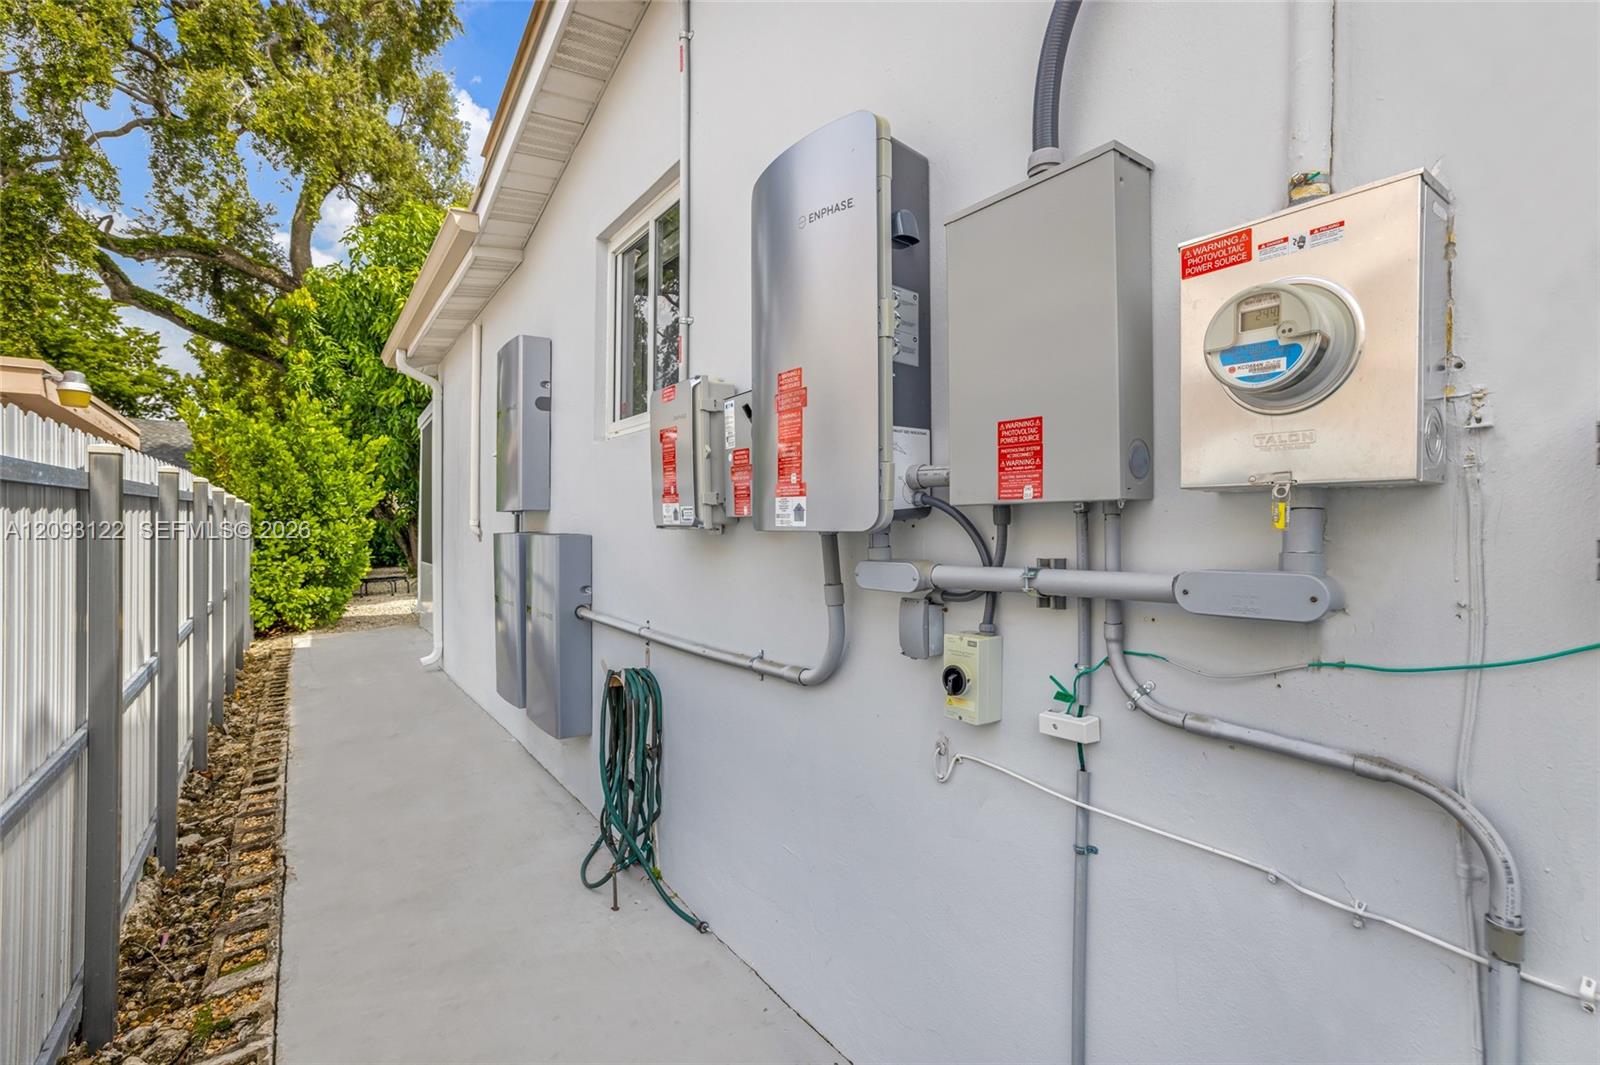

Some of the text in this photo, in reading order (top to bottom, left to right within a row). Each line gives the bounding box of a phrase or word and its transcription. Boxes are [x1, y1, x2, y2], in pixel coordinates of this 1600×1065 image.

[808, 197, 854, 224] ENPHASE
[1187, 243, 1245, 267] PHOTOVOLTAIC
[1192, 235, 1239, 256] WARNING
[1185, 261, 1213, 276] POWER
[1214, 251, 1248, 268] SOURCE
[1005, 420, 1035, 429] WARNING
[1005, 458, 1035, 467] WARNING
